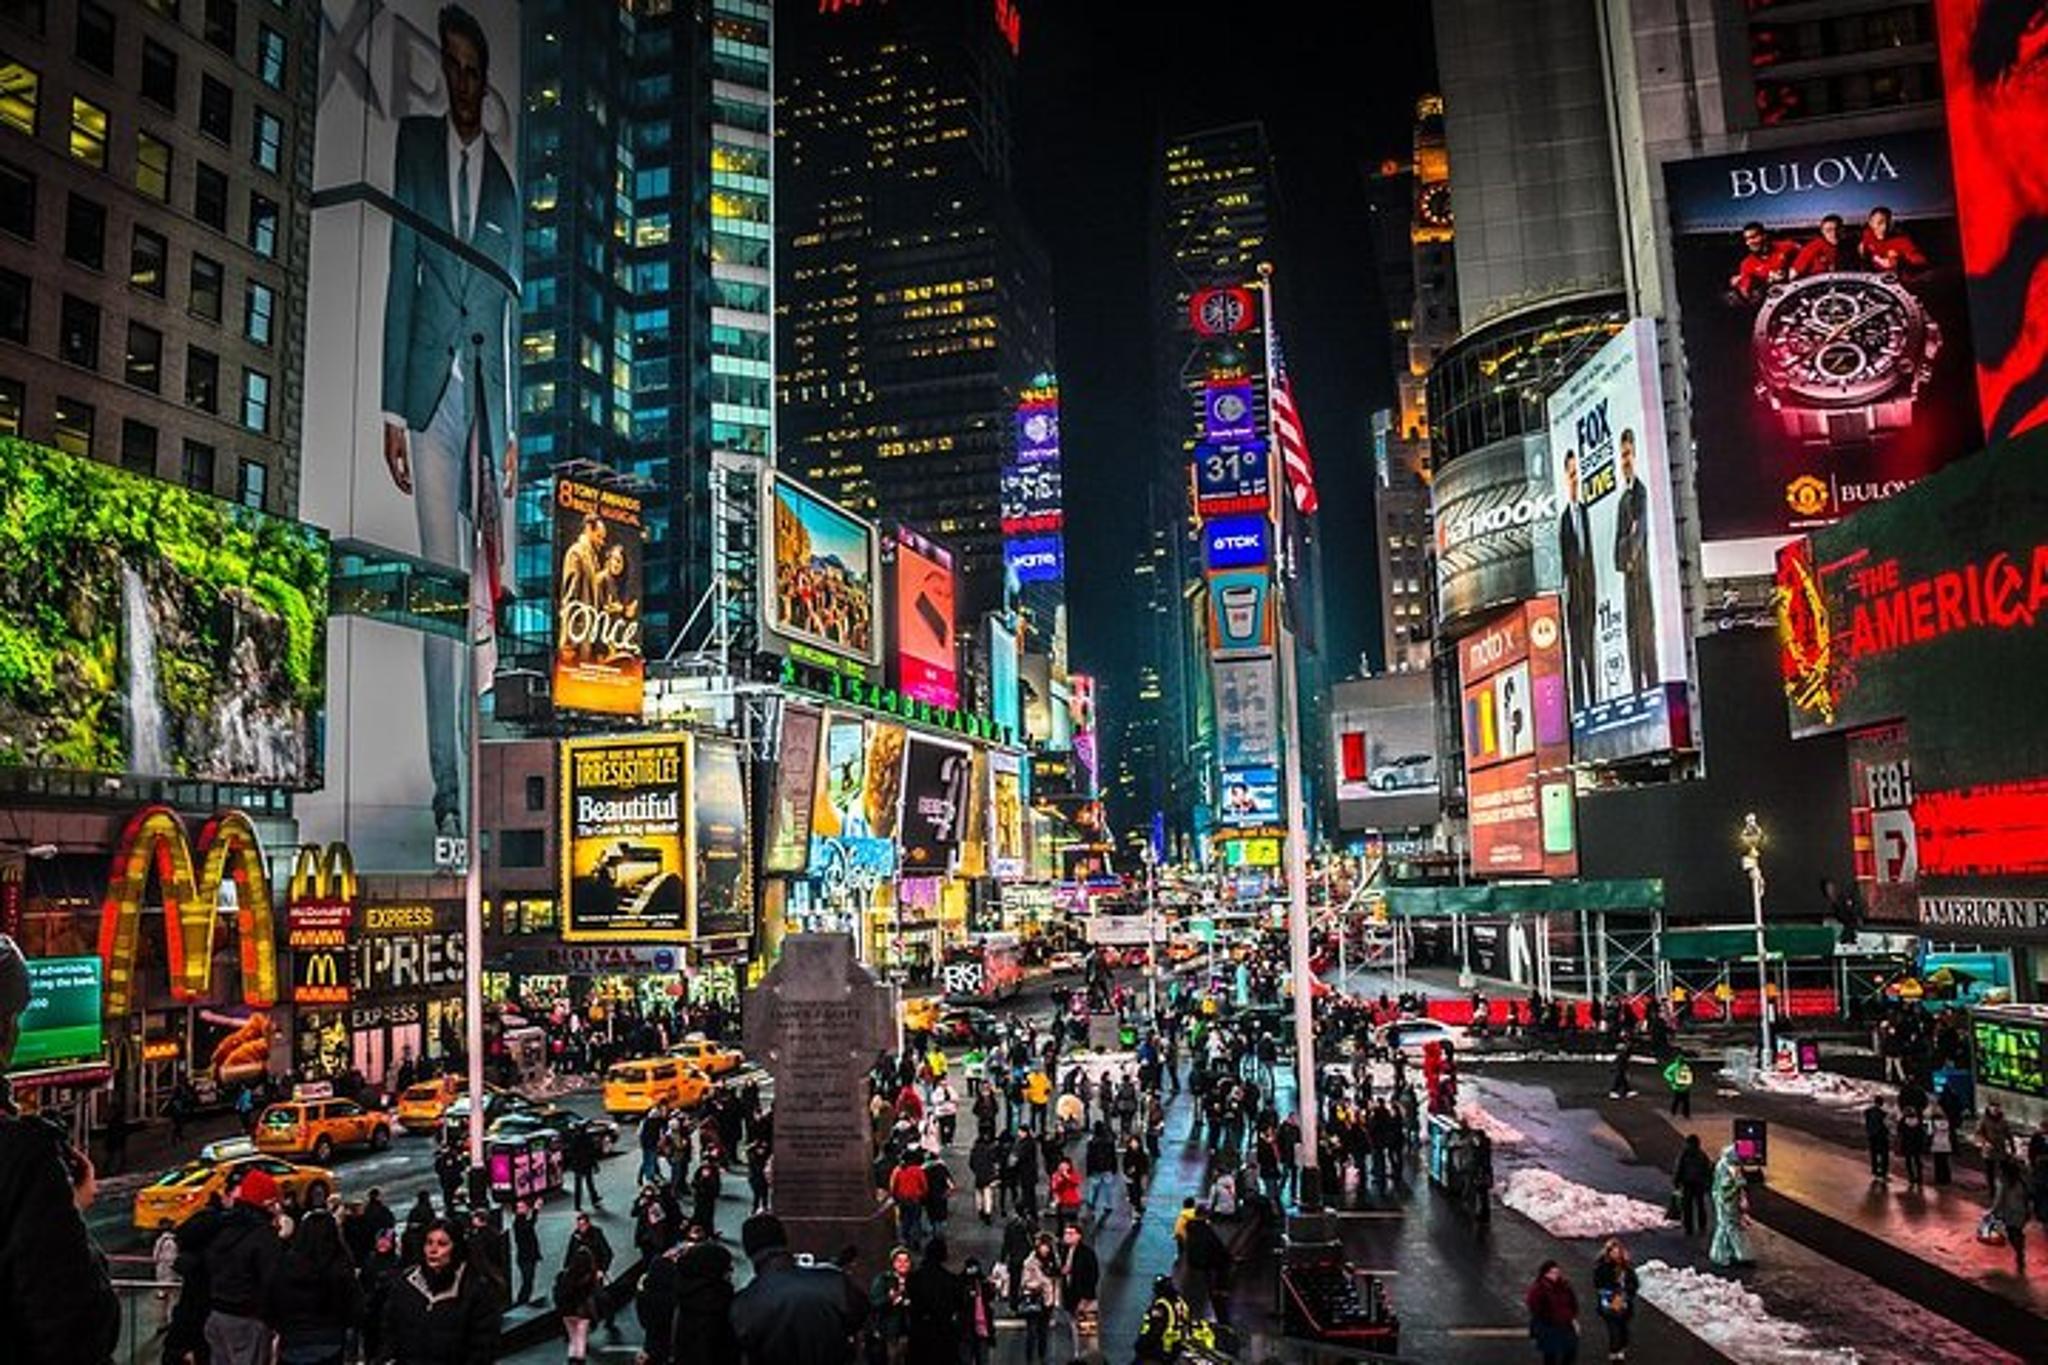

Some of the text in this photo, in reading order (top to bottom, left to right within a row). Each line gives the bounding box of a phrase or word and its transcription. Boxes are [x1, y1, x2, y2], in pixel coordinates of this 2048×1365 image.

[1730, 152, 1898, 198] BULOVA
[1577, 398, 1611, 458] FOX
[558, 480, 573, 508] 8
[1582, 466, 1615, 503] LIVE
[1841, 479, 1916, 502] BULOV
[1223, 535, 1260, 549] TDK
[1852, 559, 1899, 597] THE
[1470, 629, 1502, 672] moto
[1867, 764, 1901, 808] FEB
[577, 791, 678, 822] Beautiful
[367, 908, 433, 928] EXPRESS
[1918, 899, 2026, 928] AMERICAN
